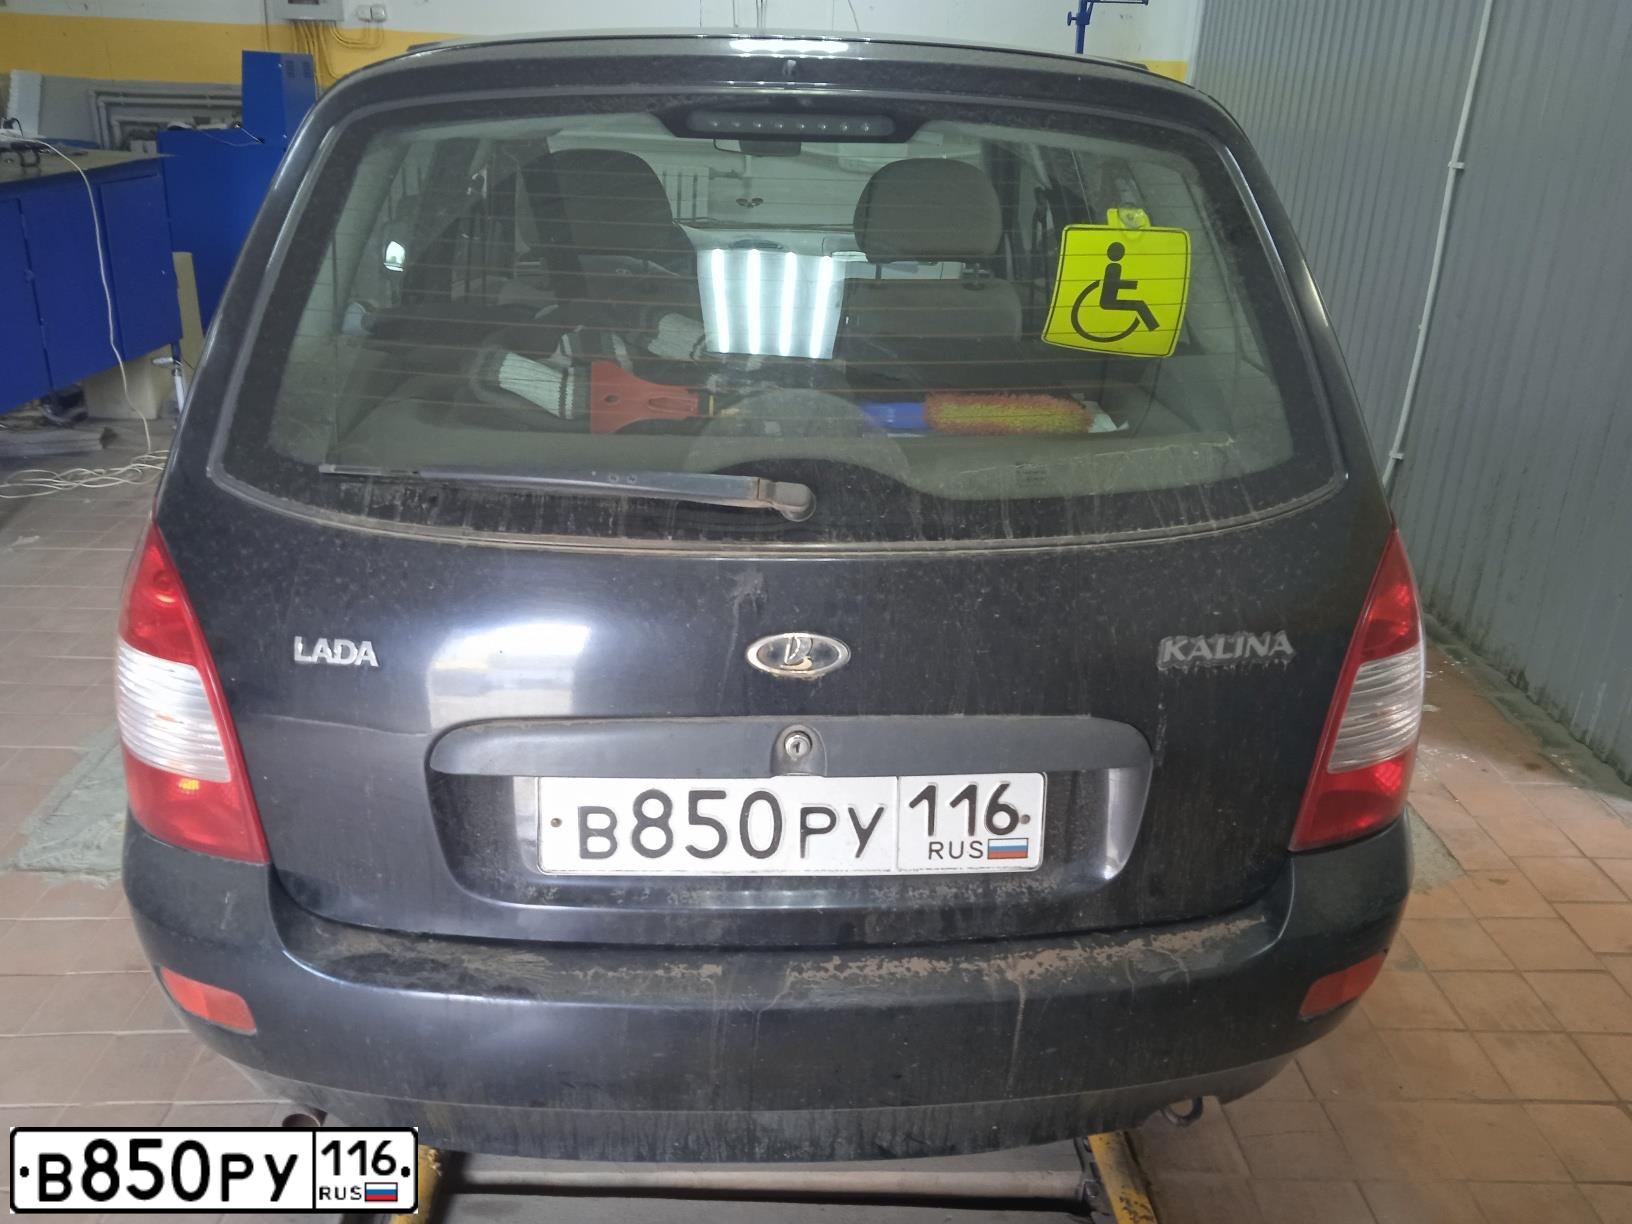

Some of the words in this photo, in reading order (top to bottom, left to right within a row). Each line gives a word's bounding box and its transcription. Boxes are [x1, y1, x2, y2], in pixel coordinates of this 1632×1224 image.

[294, 635, 379, 668] LADA
[1161, 629, 1295, 663] KALINA
[908, 782, 1020, 837] 116
[928, 840, 984, 861] RUS
